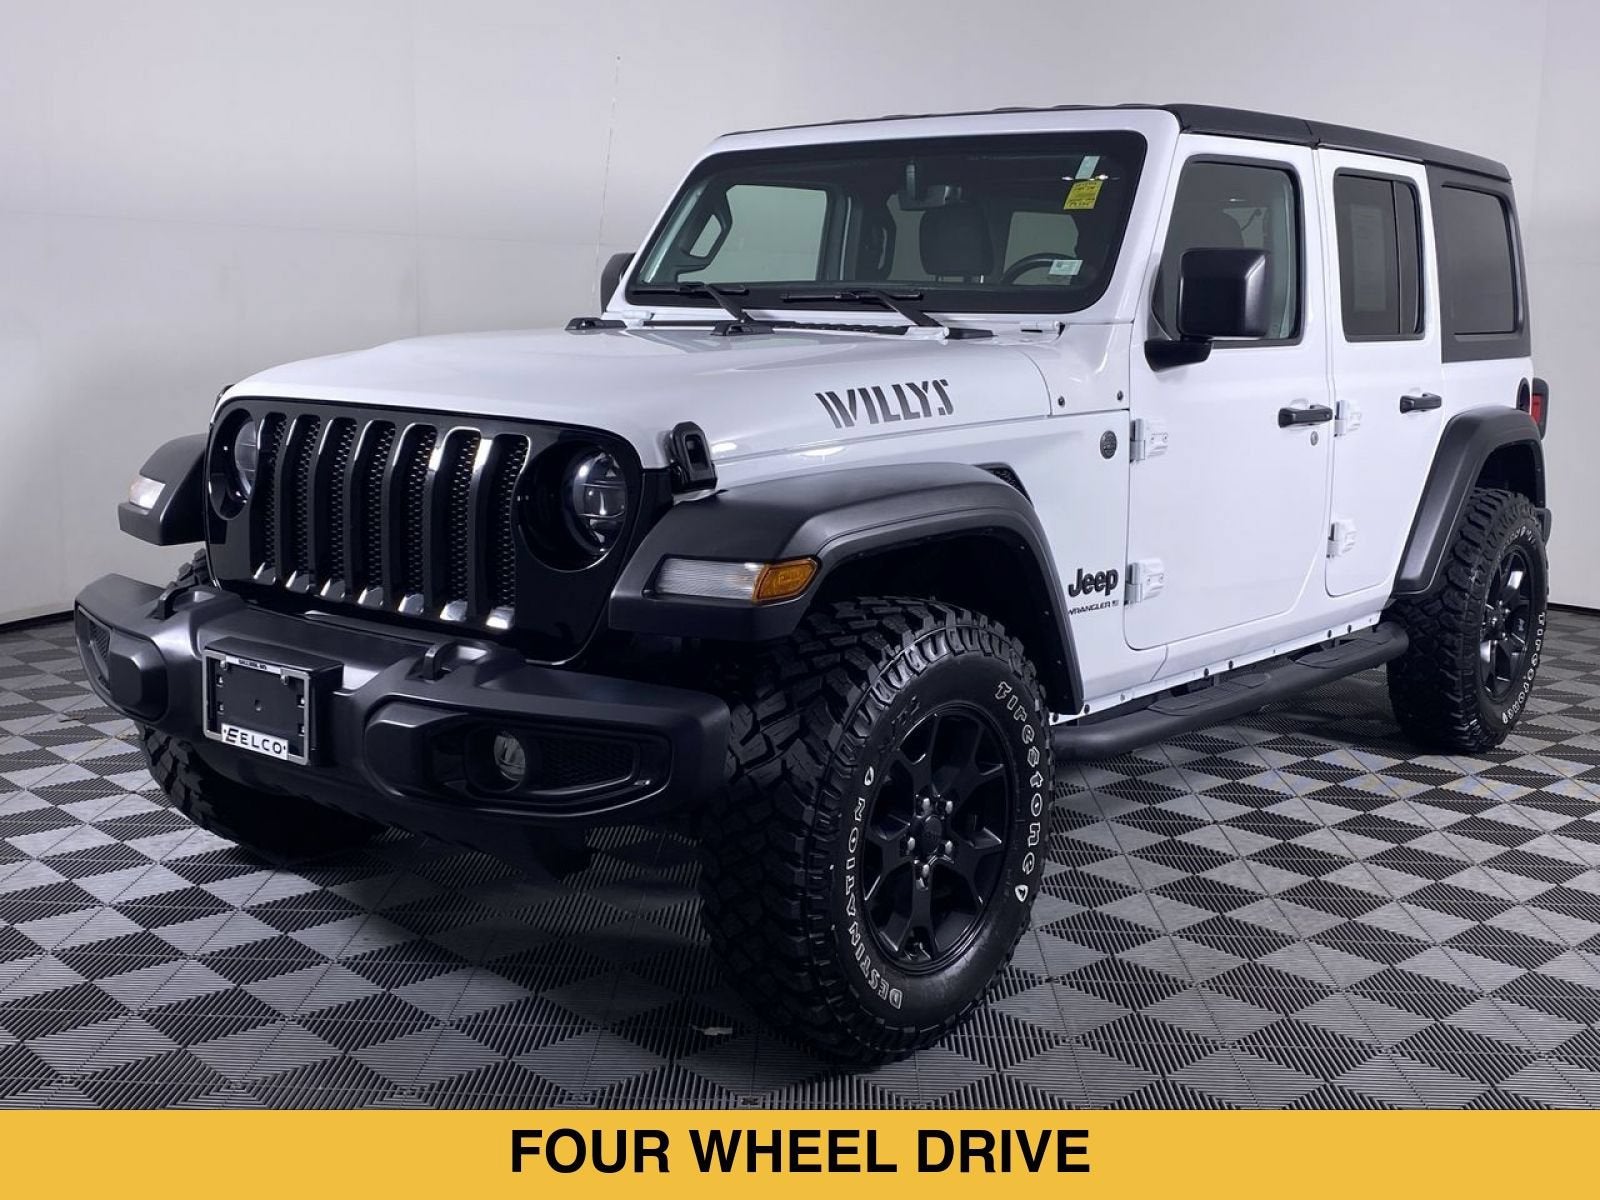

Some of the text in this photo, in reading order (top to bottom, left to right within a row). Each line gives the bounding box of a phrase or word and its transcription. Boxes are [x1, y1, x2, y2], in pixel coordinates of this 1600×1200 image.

[815, 379, 954, 429] WILLYS
[1068, 568, 1119, 597] Jeep
[845, 797, 903, 1010] DESTINATION
